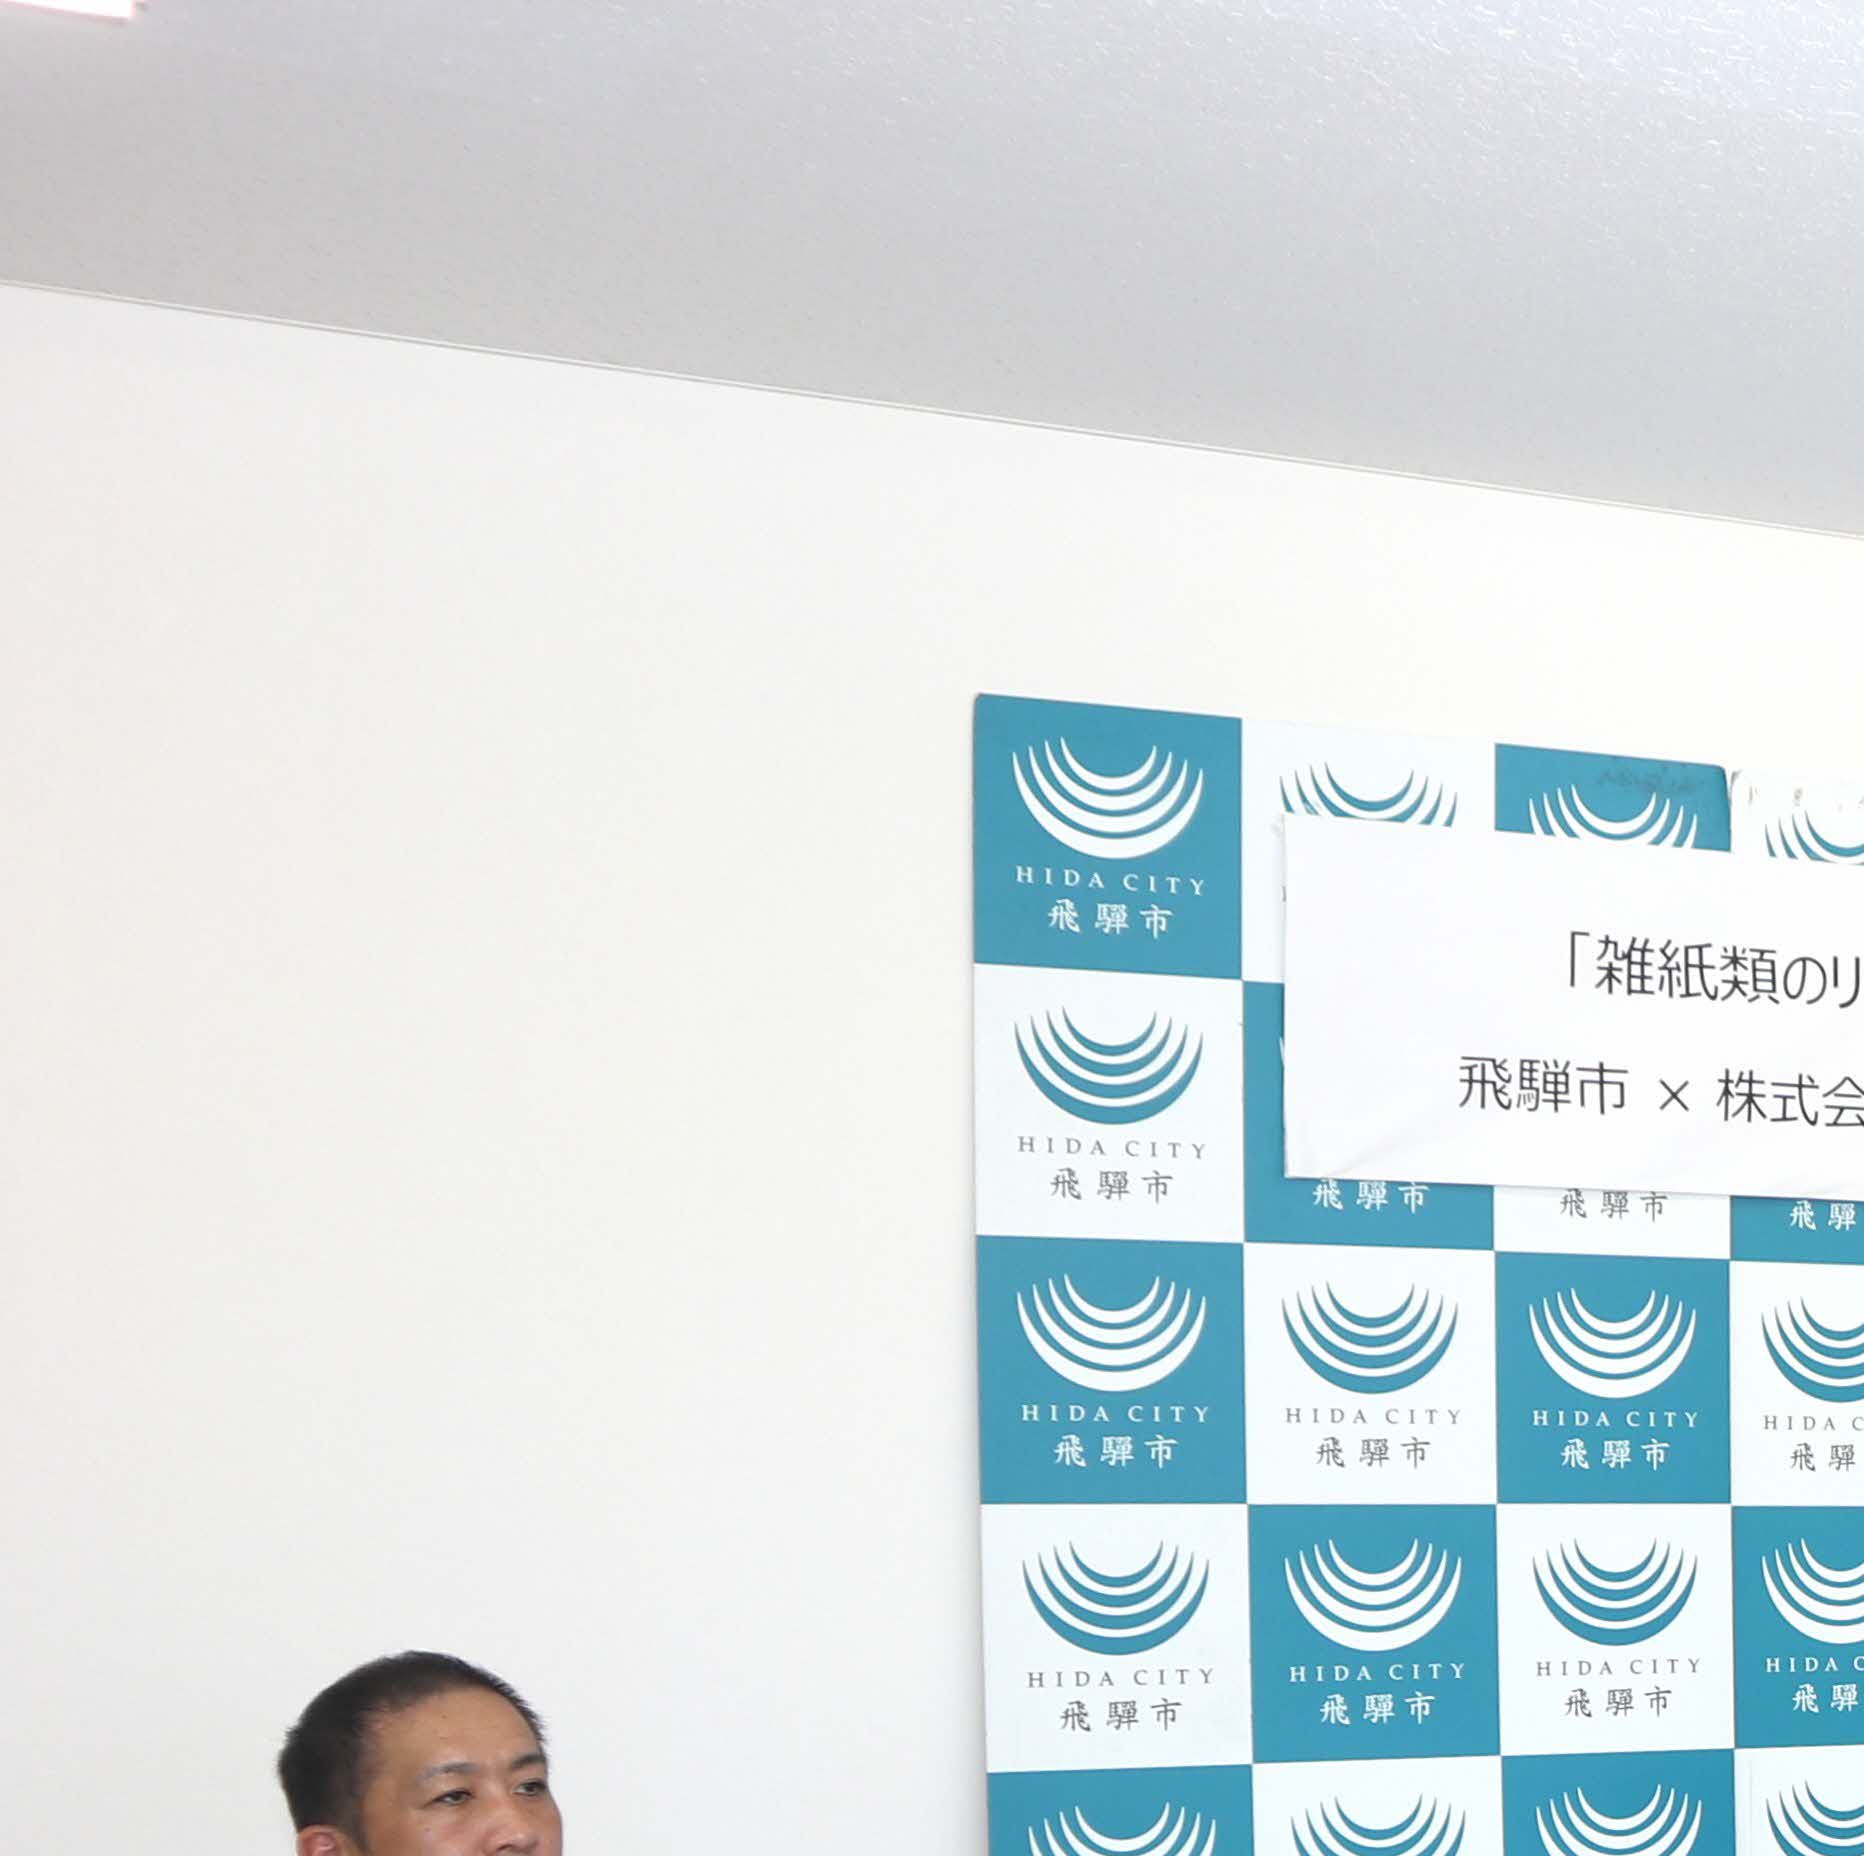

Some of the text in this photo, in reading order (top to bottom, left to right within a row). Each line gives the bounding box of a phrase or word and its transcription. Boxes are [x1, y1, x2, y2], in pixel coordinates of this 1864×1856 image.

[1015, 865, 1205, 897] HIDA CITY
[1458, 1056, 1629, 1115] 飛騨市
[1017, 1135, 1205, 1160] HIDA CITY
[1021, 1404, 1209, 1424] HIDA CITY
[1285, 1407, 1461, 1426] HIDA CITY
[1763, 1414, 1836, 1432] HIDA
[1536, 1658, 1700, 1677] HIDA CITY
[1765, 1656, 1839, 1674] HIDA
[1027, 1668, 1213, 1689] HIDA CITY
